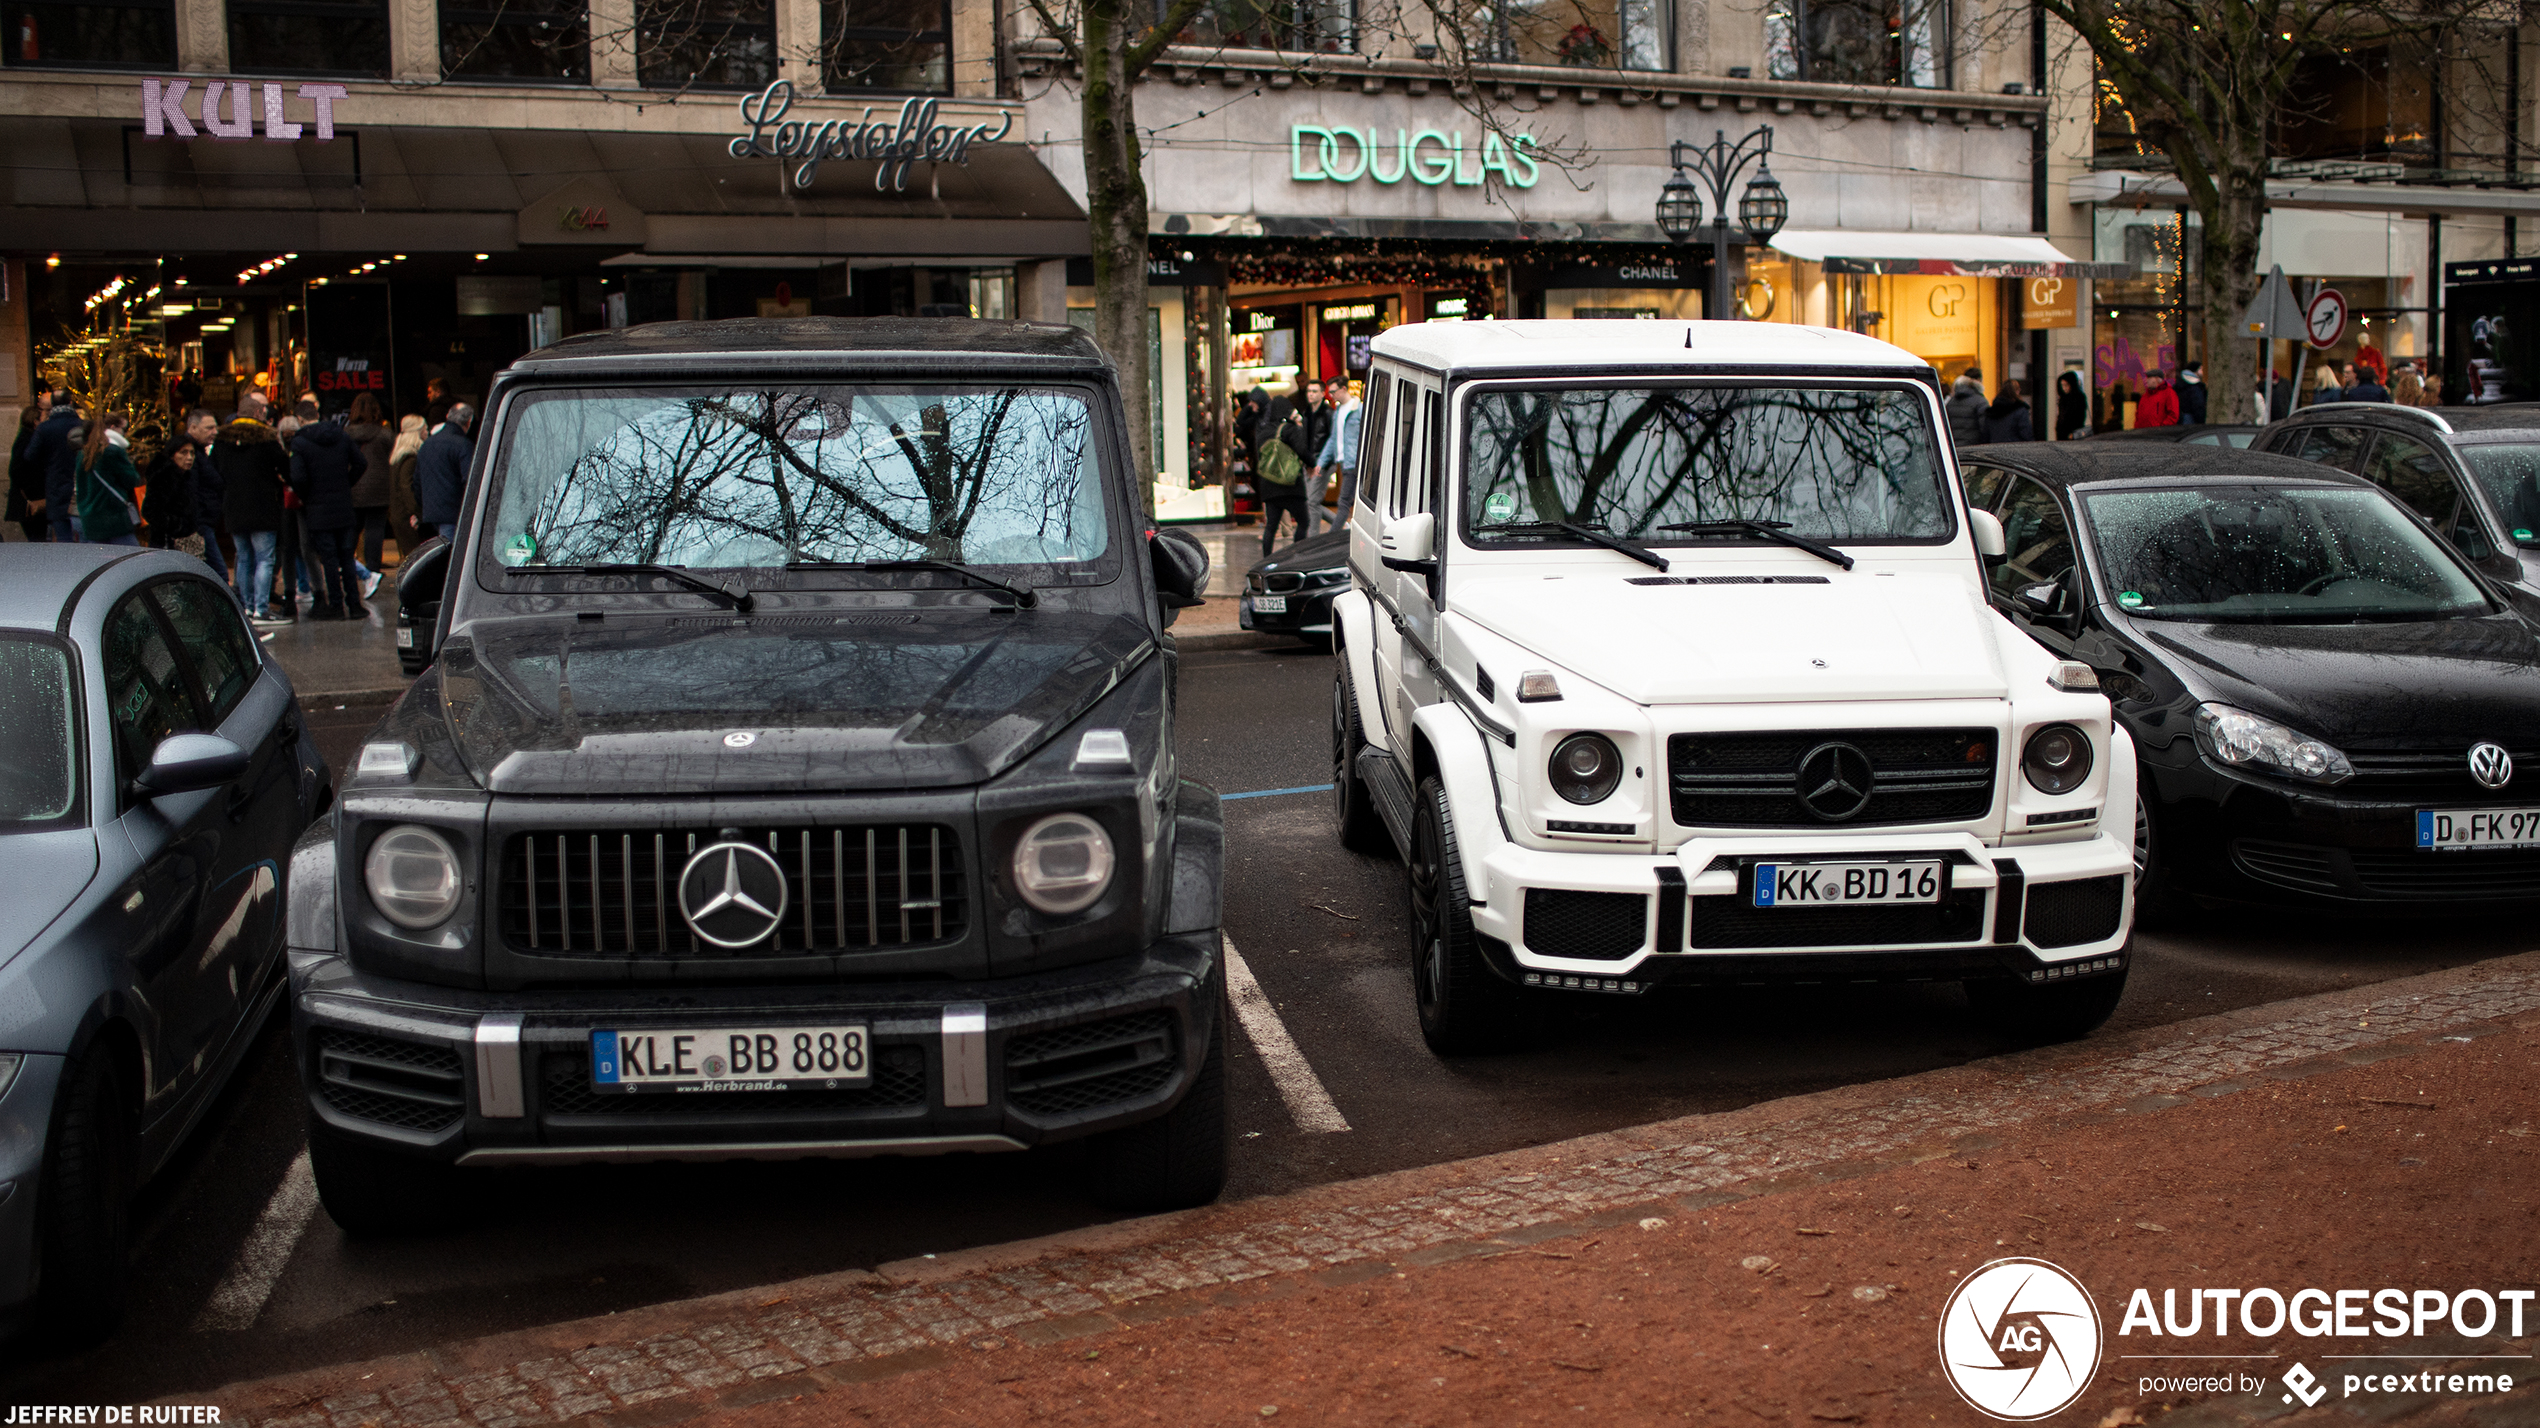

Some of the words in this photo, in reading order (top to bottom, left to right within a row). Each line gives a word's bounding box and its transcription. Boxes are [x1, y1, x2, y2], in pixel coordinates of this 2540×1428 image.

[142, 79, 349, 140] KULT
[729, 79, 1012, 191] Leysieffer
[1292, 124, 1539, 188] DOUGLAS
[1148, 260, 1180, 275] NEL
[1619, 265, 1679, 279] CHANEL
[1928, 283, 1966, 319] GP
[2031, 276, 2063, 306] GP
[1250, 312, 1275, 331] Dior
[318, 371, 385, 391] SALE
[2436, 815, 2453, 842] D
[2471, 813, 2505, 841] FK
[1761, 889, 1770, 899] D
[1777, 869, 1822, 901] KK
[1844, 868, 1889, 899] BD
[1895, 867, 1936, 899] 16
[602, 1061, 612, 1074] D
[621, 1035, 698, 1077] KLE
[729, 1034, 779, 1074] BB
[793, 1031, 864, 1073] 888
[677, 1080, 788, 1093] www.Herbrand.de
